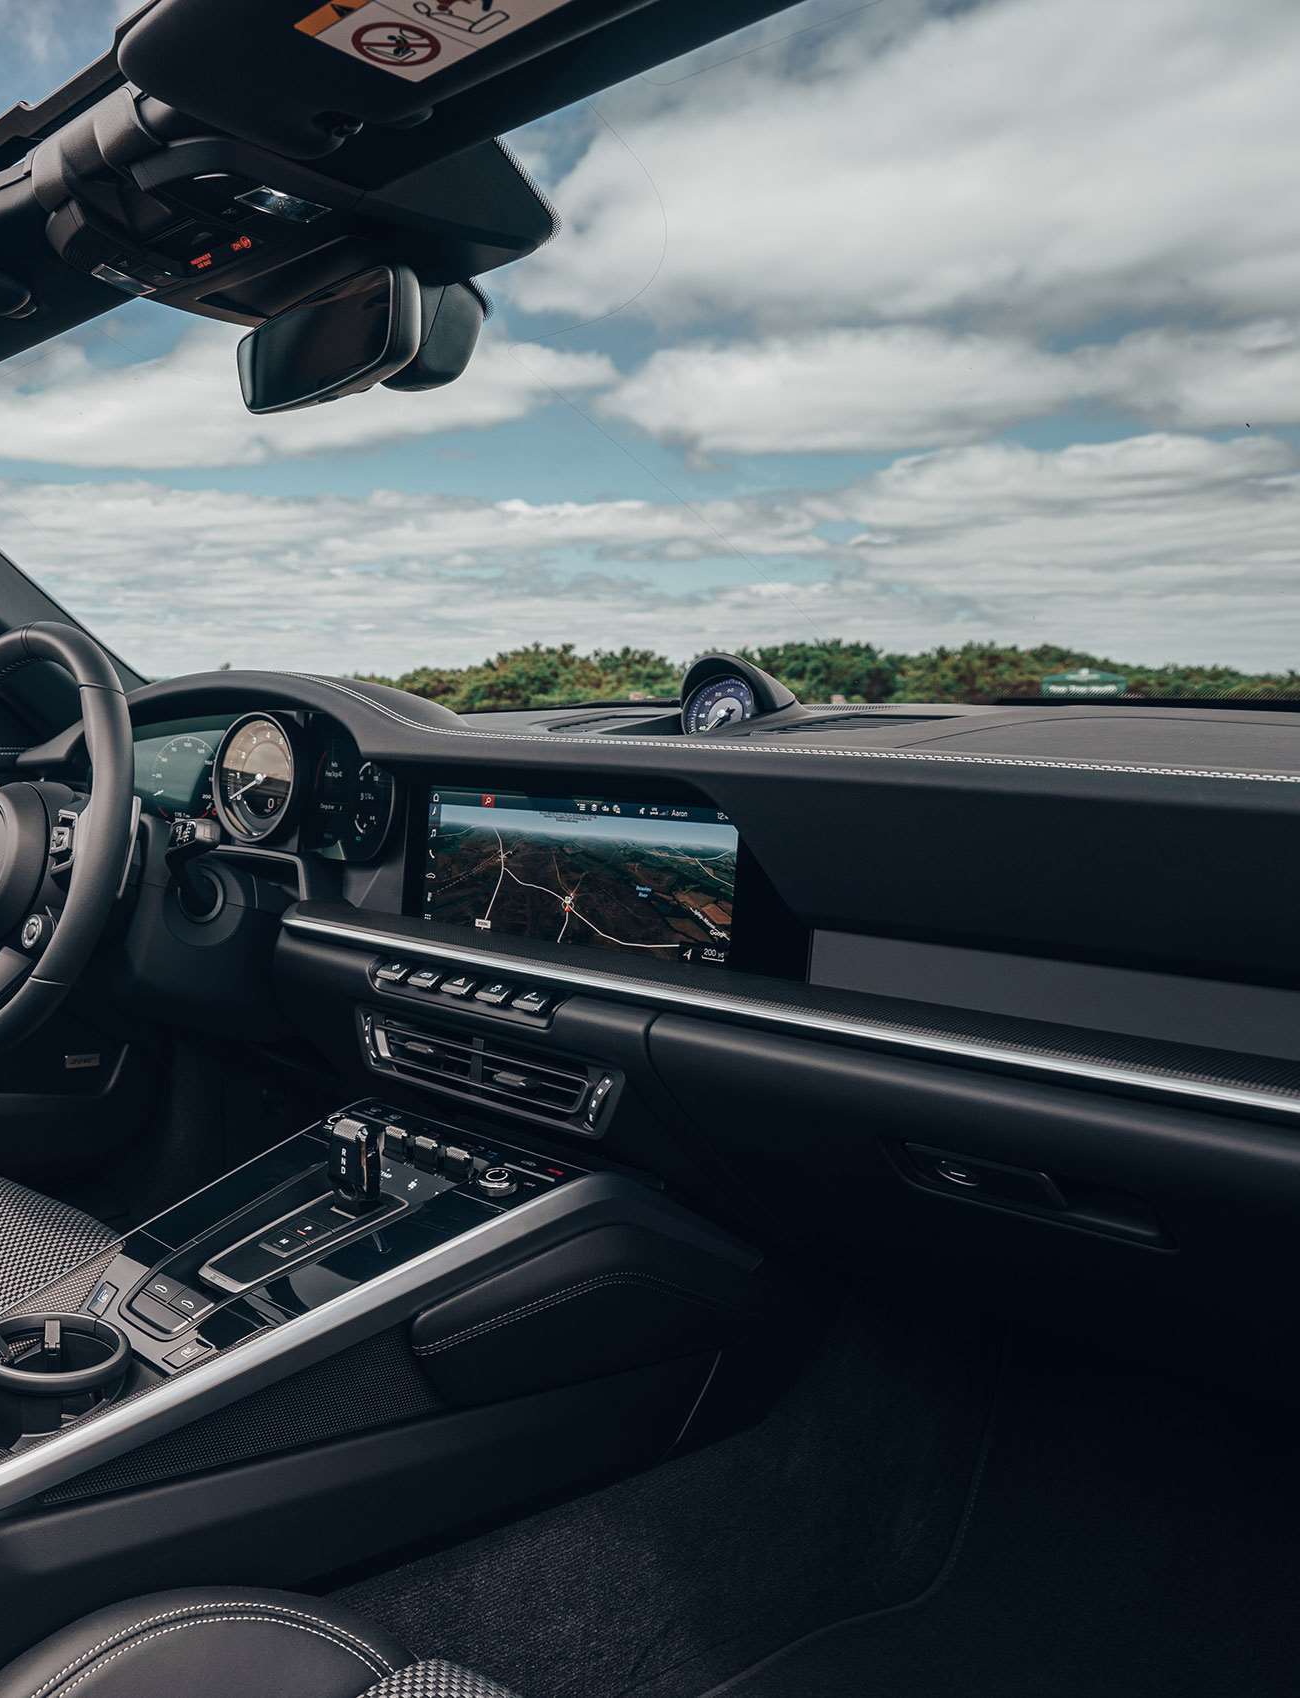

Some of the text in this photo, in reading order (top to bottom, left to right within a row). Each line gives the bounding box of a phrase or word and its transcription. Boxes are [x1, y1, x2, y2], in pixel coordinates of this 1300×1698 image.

[267, 798, 275, 809] 0
[670, 809, 688, 817] Aaron
[703, 948, 717, 957] 200
[341, 1148, 347, 1157] R
[341, 1157, 347, 1166] N
[341, 1166, 347, 1175] D
